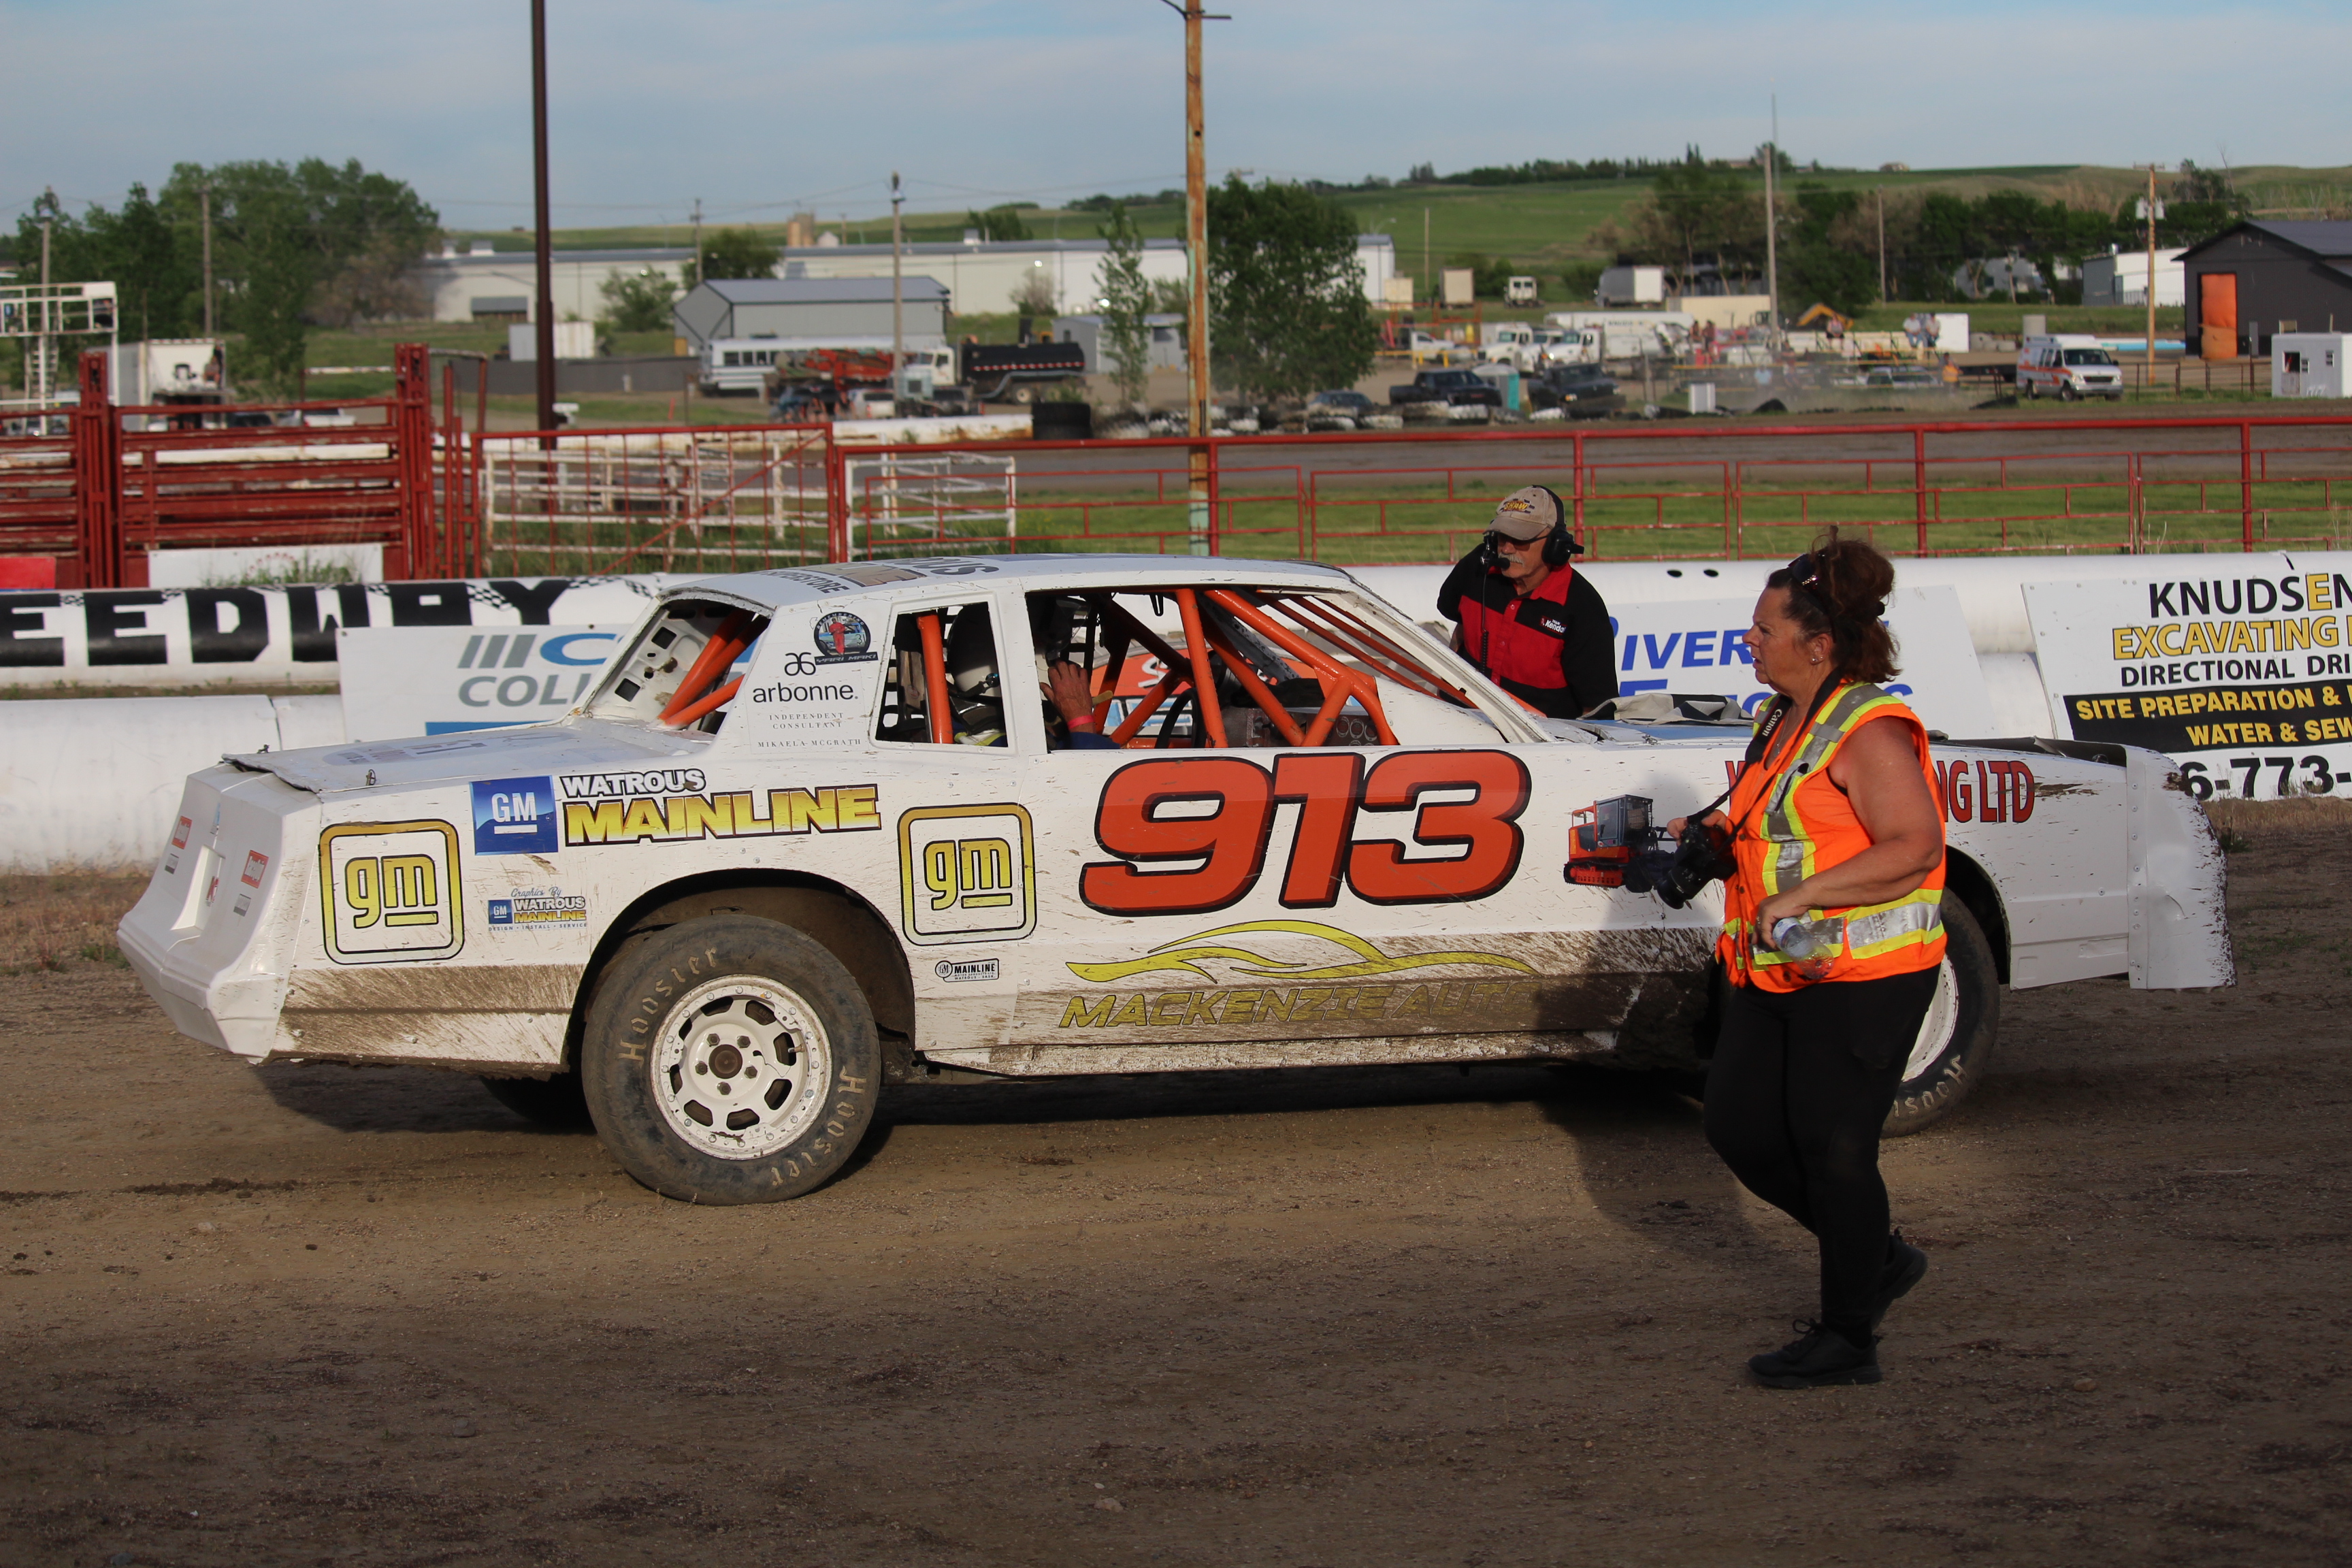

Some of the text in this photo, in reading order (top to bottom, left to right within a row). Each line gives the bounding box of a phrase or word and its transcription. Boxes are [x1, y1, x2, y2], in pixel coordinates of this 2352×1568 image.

[1504, 502, 1529, 510] SHAW
[2149, 572, 2352, 618] KNUDSEN
[2112, 615, 2340, 660] EXCAVATING
[2121, 658, 2295, 687] DIRECTIONAL
[769, 713, 844, 721] INDEPENDENT
[2076, 698, 2135, 721] SITE
[2140, 686, 2315, 718] PREPARATION
[2322, 685, 2341, 706] &
[772, 721, 843, 730] CONSULTANT
[1762, 708, 1782, 736] Canon
[2186, 722, 2274, 746] WATER
[2280, 723, 2299, 742] &
[559, 768, 706, 798] WATROUS
[1976, 760, 2035, 823] LTD
[490, 791, 537, 823] GM
[563, 784, 882, 847] MAINLINE
[1079, 750, 1532, 917] 913
[924, 837, 1013, 911] gm
[344, 853, 438, 929] gm
[510, 886, 562, 898] Graphics By
[514, 896, 586, 911] WATROUS
[493, 905, 507, 916] GM
[514, 910, 587, 924] MAINLINE
[954, 964, 995, 974] MAINLINE
[1059, 981, 1543, 1028] MACKENZIE AUTO
